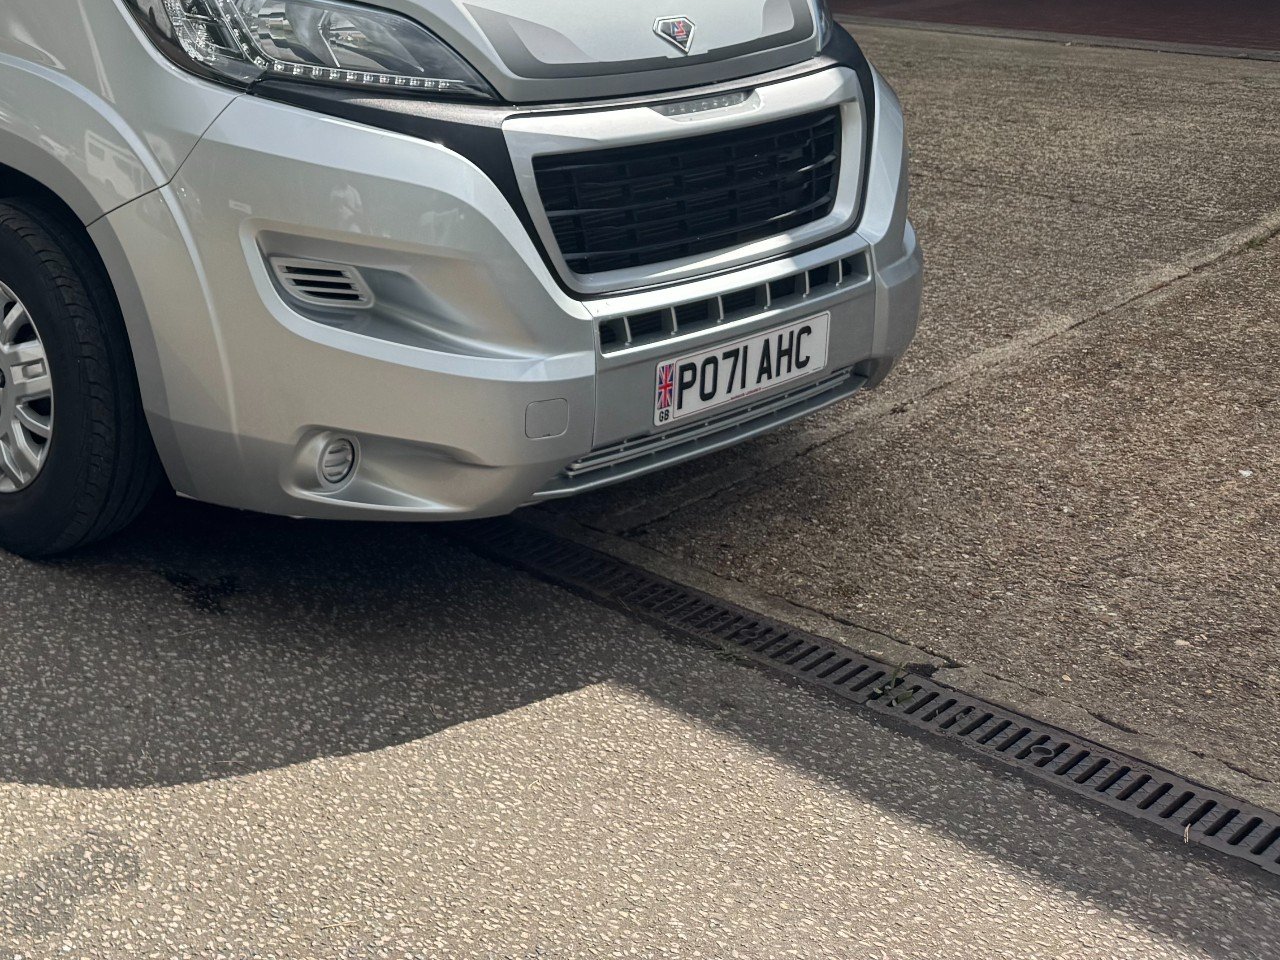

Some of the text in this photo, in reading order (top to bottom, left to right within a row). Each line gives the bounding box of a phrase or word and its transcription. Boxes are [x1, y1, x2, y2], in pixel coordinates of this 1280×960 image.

[676, 325, 812, 410] PO71 AHC
[658, 409, 670, 423] GB
